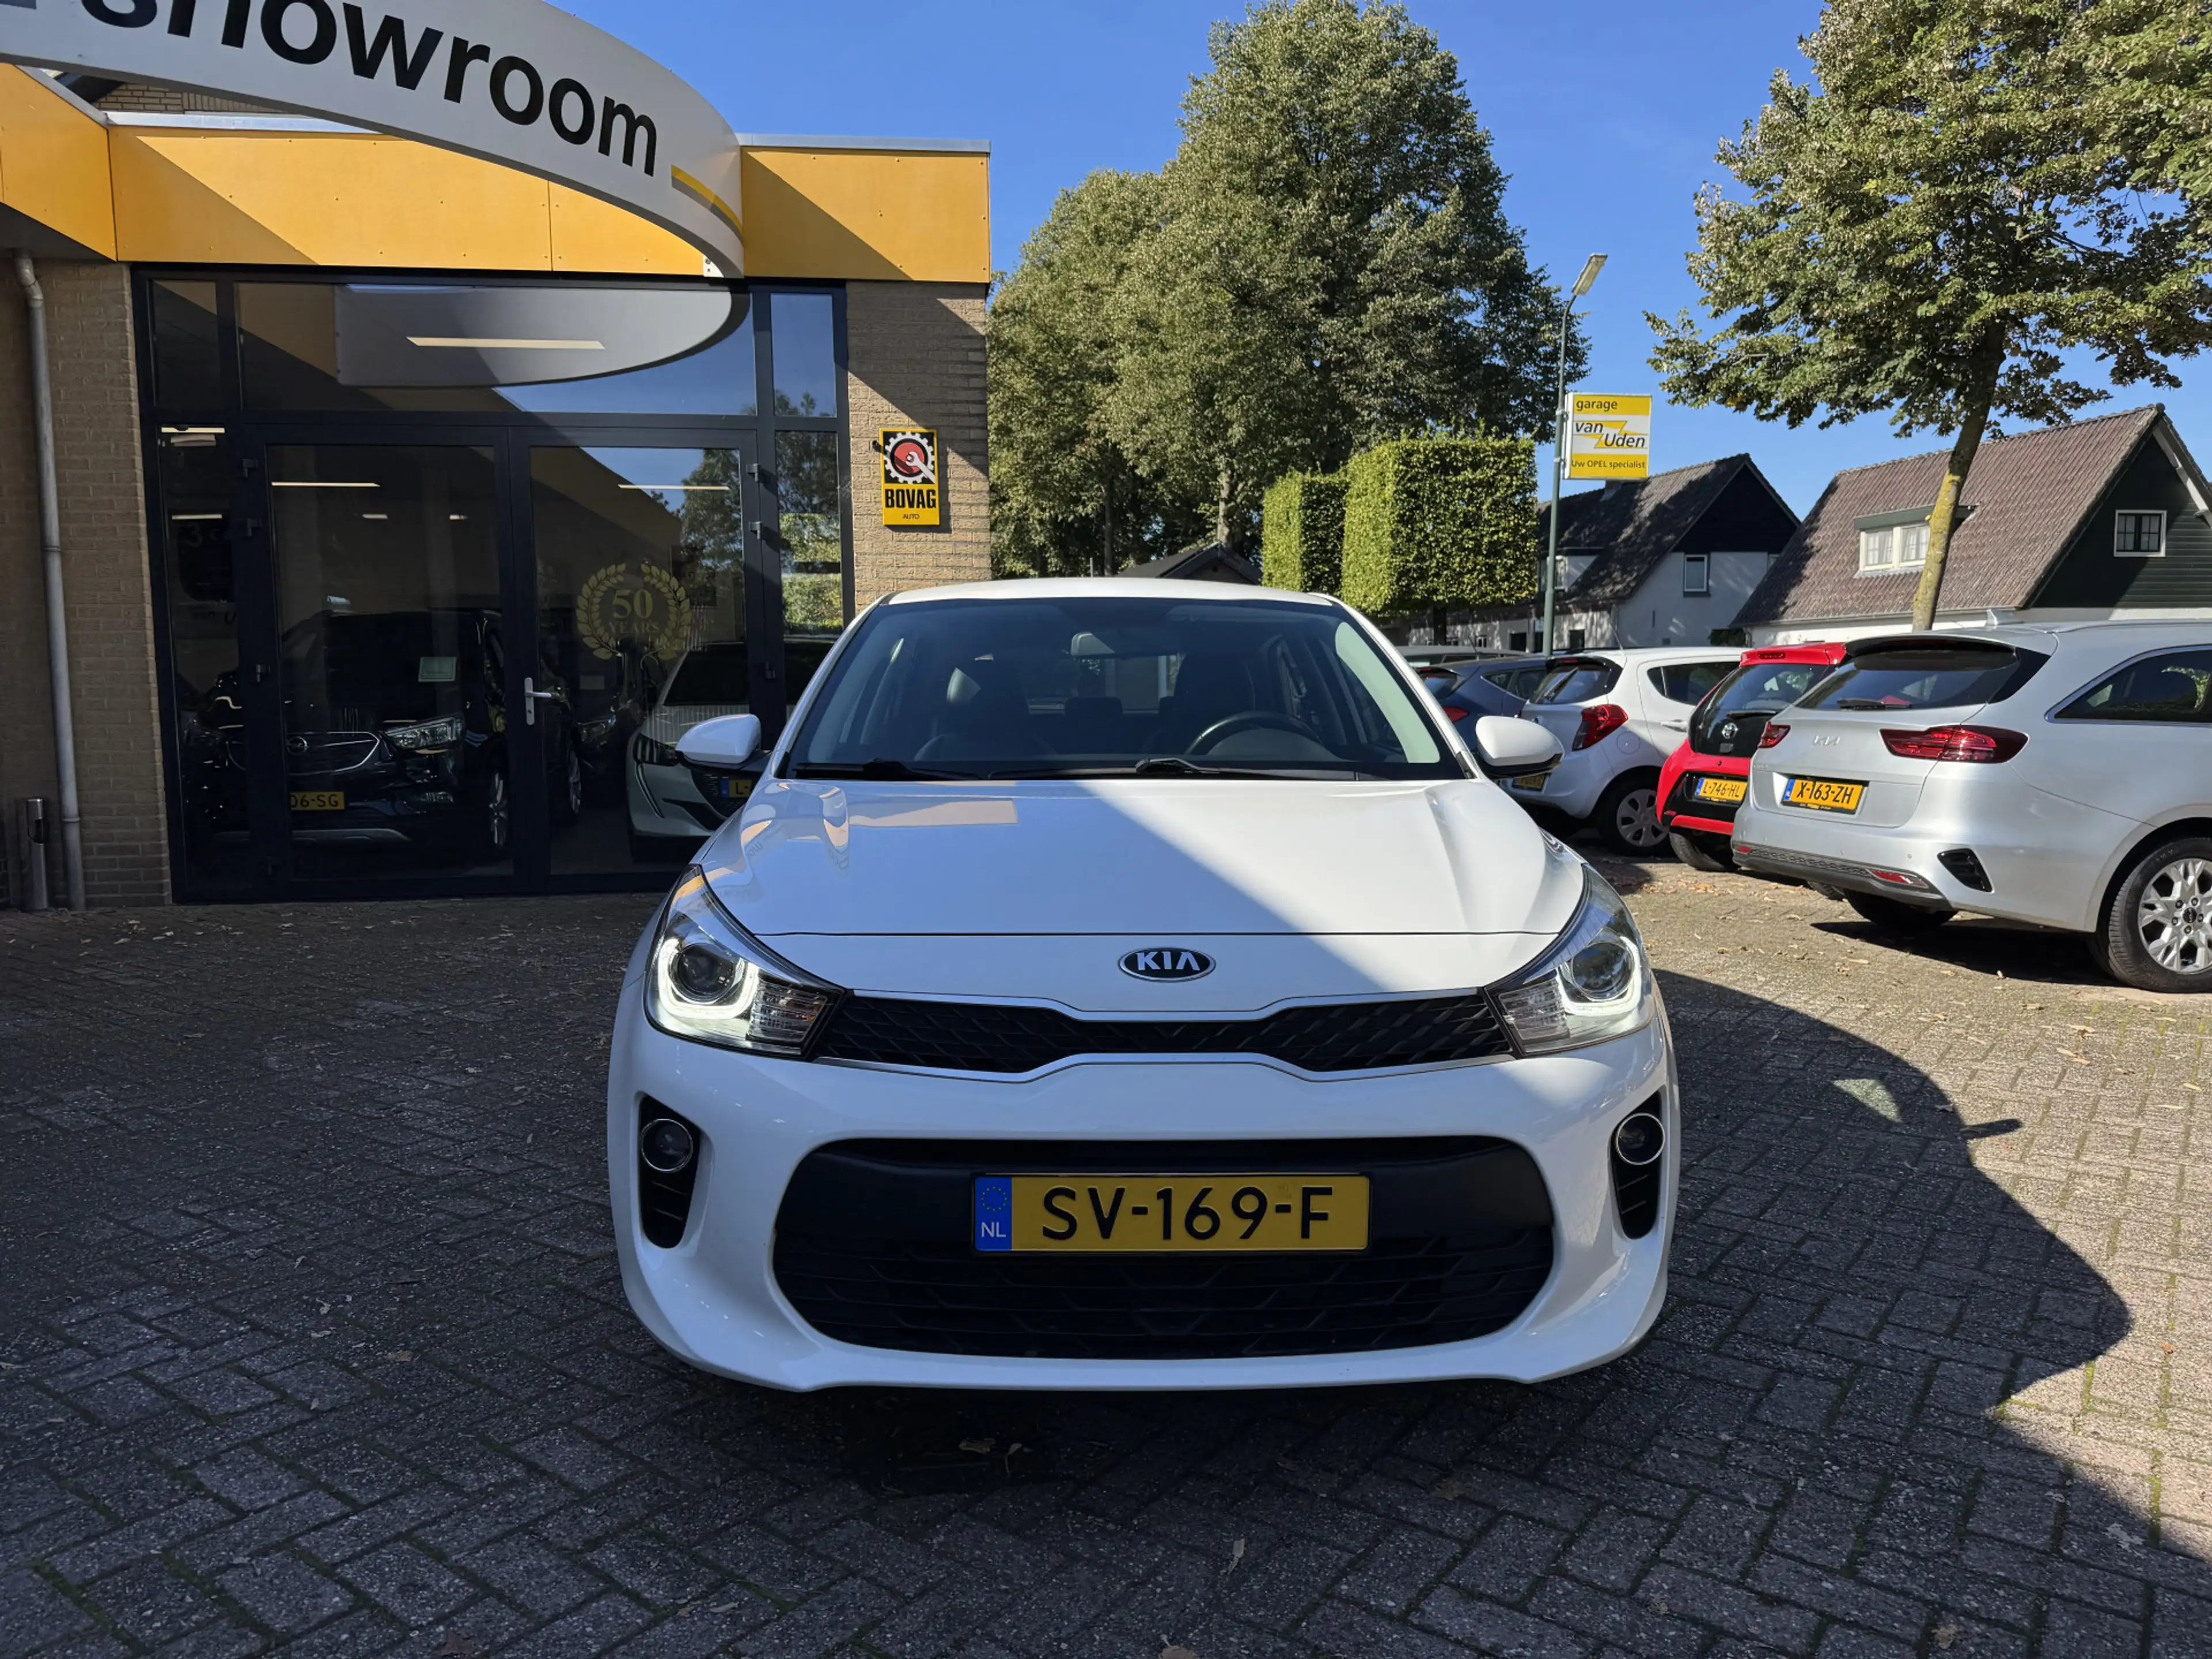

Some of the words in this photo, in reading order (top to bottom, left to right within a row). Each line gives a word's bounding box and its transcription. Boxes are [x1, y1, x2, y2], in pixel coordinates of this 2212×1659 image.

[1576, 400, 1618, 411] garage
[1575, 422, 1603, 433] van
[1604, 433, 1645, 448] Uden
[1571, 460, 1585, 468] Uw
[1587, 460, 1607, 468] OPEL
[1609, 460, 1646, 469] specialist
[885, 488, 936, 508] BOVAG
[612, 589, 653, 619] 50
[1703, 781, 1740, 798] L-746-HL
[1796, 781, 1854, 805] X-163-ZH
[1137, 951, 1200, 971] KIA
[981, 1221, 1007, 1238] NL
[1042, 1185, 1334, 1241] SV-169-F
